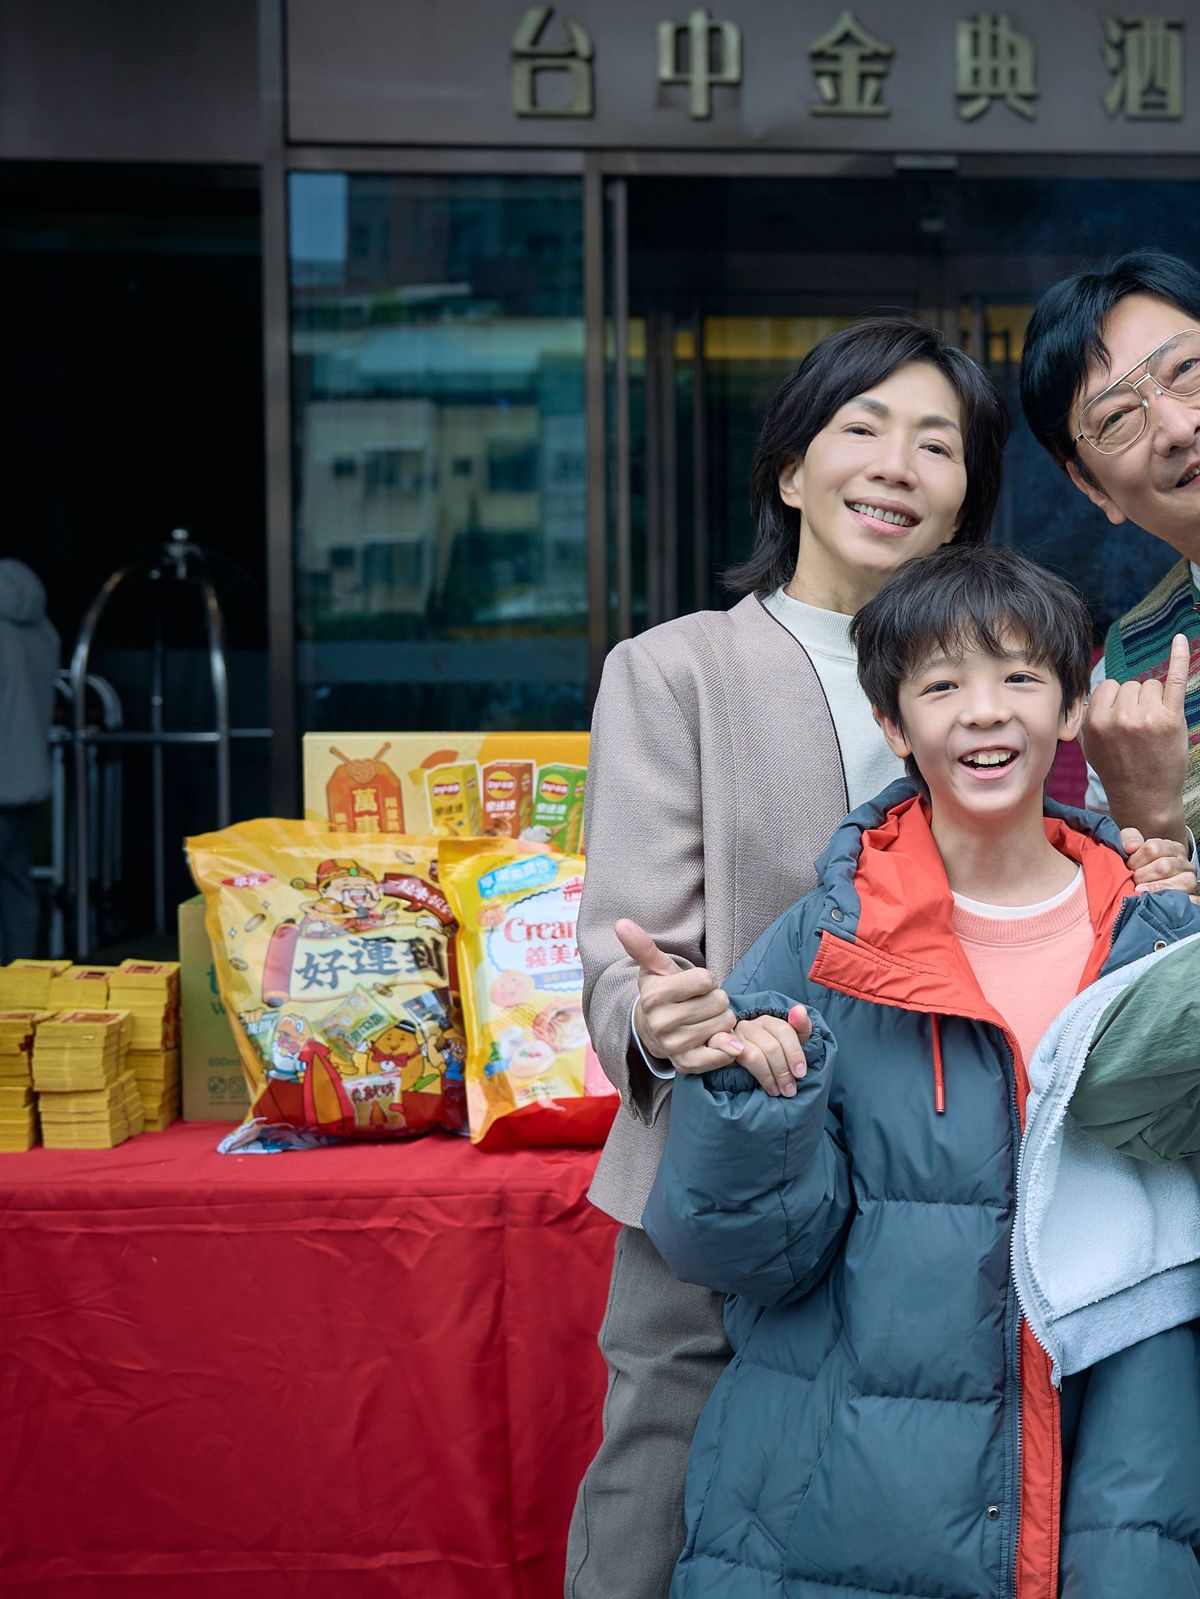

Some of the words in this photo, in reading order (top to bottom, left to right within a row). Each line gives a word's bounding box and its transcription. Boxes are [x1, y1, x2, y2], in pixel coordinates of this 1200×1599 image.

[295, 936, 447, 990] 好運到
[525, 943, 581, 968] 義美
